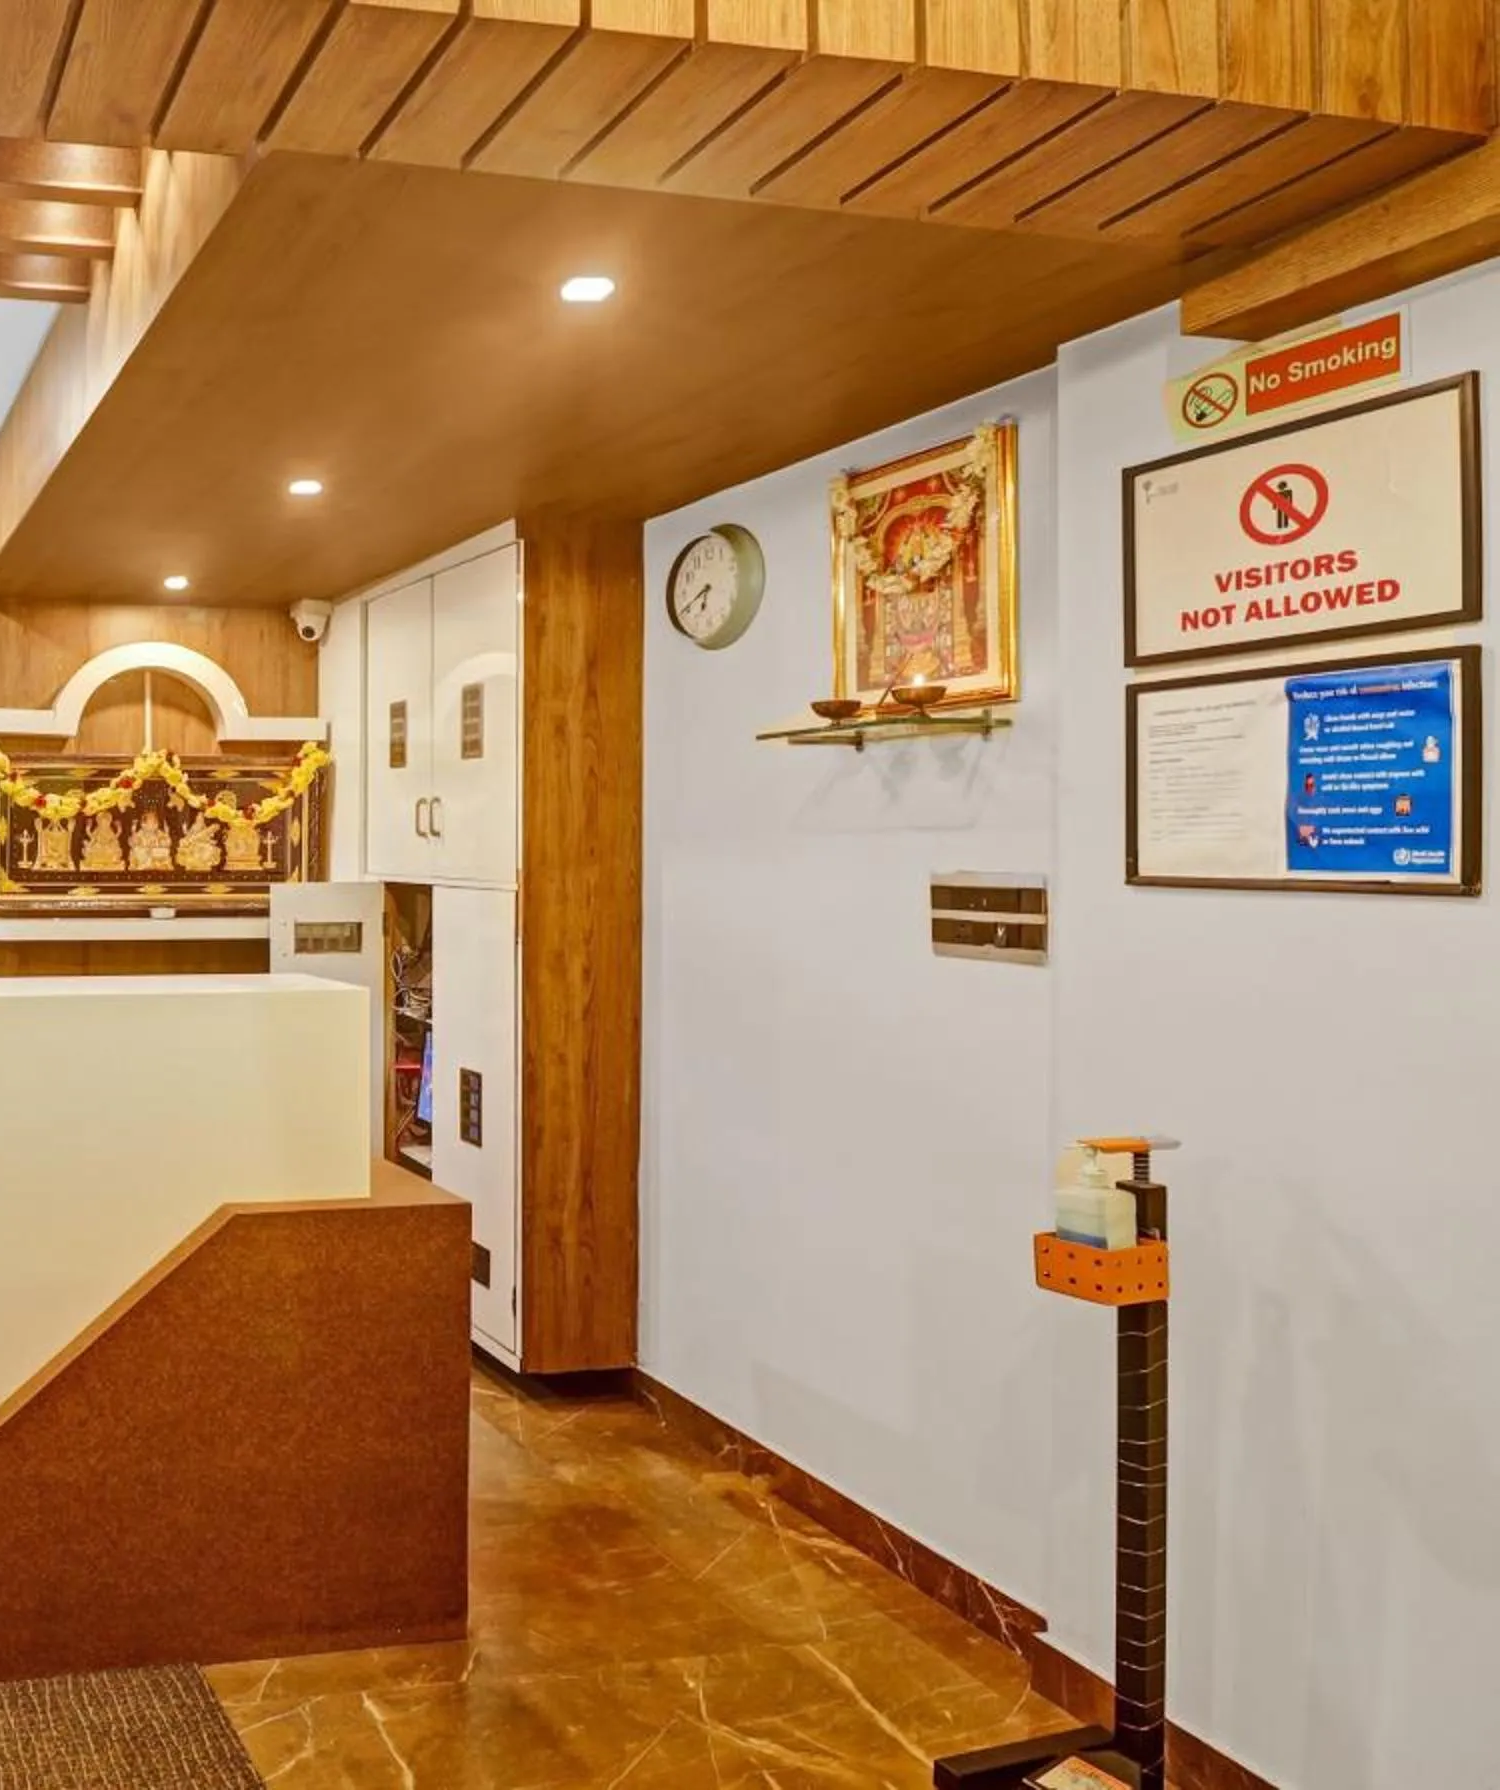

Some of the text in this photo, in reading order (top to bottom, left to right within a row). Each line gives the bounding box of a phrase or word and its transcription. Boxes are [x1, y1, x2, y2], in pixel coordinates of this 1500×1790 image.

[1250, 334, 1397, 395] No Smoking
[1214, 550, 1359, 593] VISITORS
[1180, 578, 1401, 632] NOT ALLOWED
